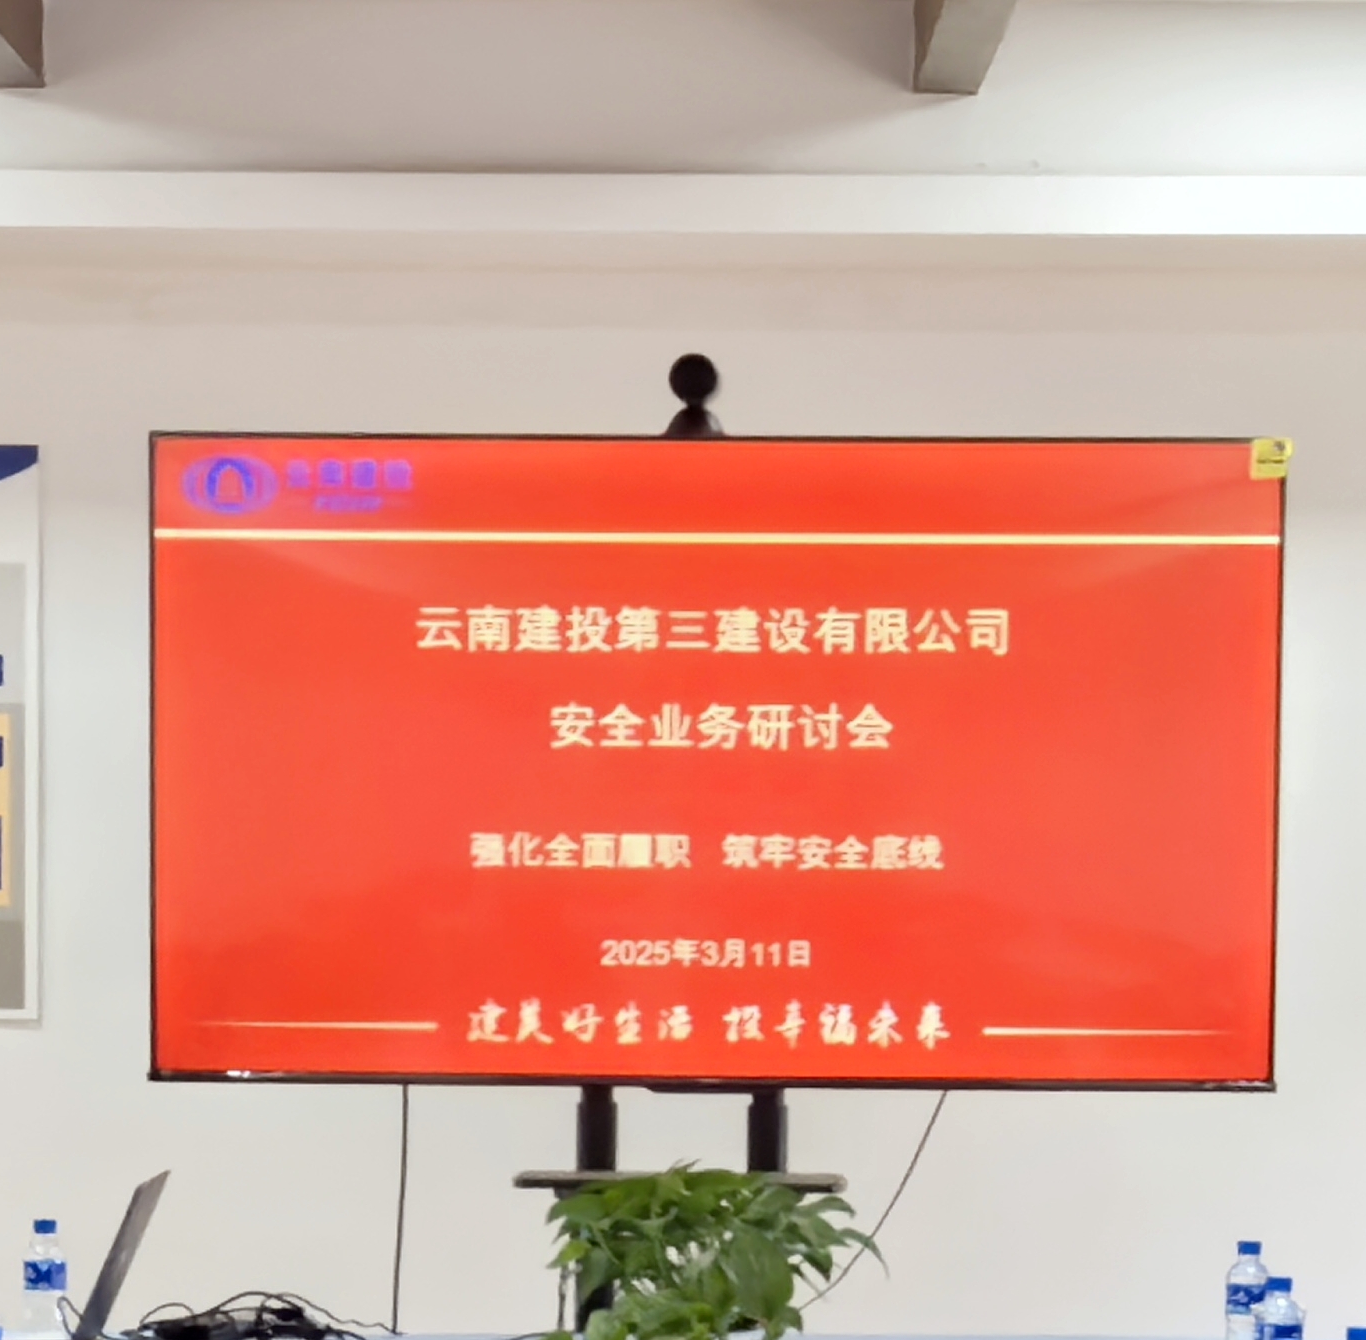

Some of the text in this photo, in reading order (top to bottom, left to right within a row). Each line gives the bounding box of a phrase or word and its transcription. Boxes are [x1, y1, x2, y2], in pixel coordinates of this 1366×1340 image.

[415, 604, 1011, 656] 云南建投第三建设有限公司
[549, 702, 894, 751] 安全业务研讨会
[469, 831, 945, 870] 强化全面履职 筑牢安全底线
[600, 938, 812, 968] 2025年3月11日
